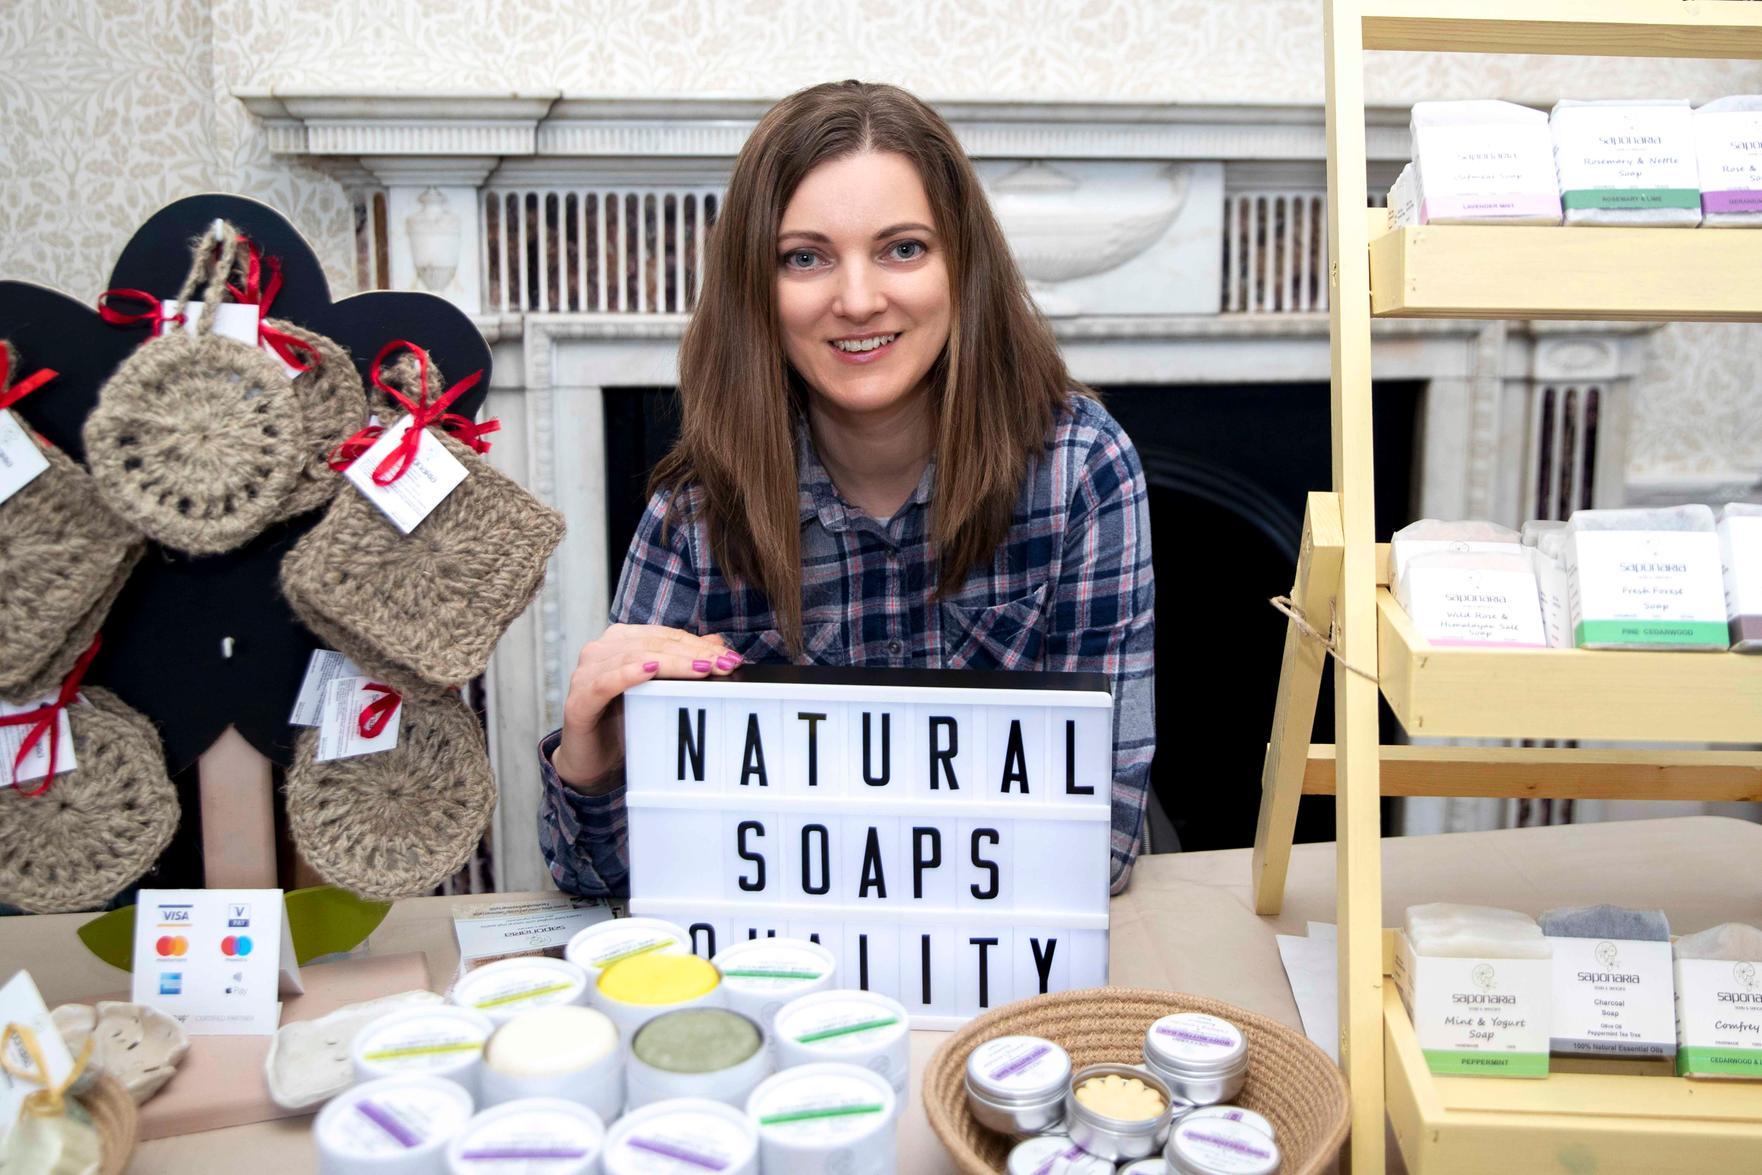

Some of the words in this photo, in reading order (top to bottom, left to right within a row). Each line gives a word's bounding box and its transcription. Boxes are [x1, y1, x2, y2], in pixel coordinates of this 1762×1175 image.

[1584, 157, 1633, 167] Rosemary
[1637, 157, 1645, 165] &
[1648, 156, 1679, 165] Nettle
[1618, 170, 1643, 178] Soap
[1722, 165, 1744, 173] Rose
[1622, 586, 1650, 595] Fresh
[1652, 586, 1683, 595] Forest
[1643, 602, 1670, 611] Soap
[1621, 628, 1640, 636] PINE
[1642, 628, 1695, 637] CEDARWOOD
[677, 707, 1095, 795] NATURAL
[736, 820, 1000, 900] SOAPS
[163, 910, 190, 921] VISA
[235, 906, 245, 917] V
[688, 922, 1058, 1009] LITY
[1577, 971, 1640, 984] saponaria
[1452, 993, 1516, 1005] saponaria
[1594, 998, 1625, 1007] Charcoal
[1601, 1009, 1620, 1018] Soap
[1444, 1016, 1473, 1027] Mint
[1477, 1016, 1486, 1026] &
[1491, 1018, 1526, 1029] Yogurt
[1715, 1020, 1760, 1033] Comfrey
[1469, 1030, 1495, 1041] Soap
[1587, 1030, 1617, 1038] Peppermint
[1573, 1042, 1592, 1050] 100%
[1593, 1043, 1617, 1051] Natural
[1619, 1044, 1649, 1053] Essential
[1650, 1046, 1664, 1054] Oils
[1461, 1058, 1509, 1066] PEPPERMINT
[1710, 1057, 1753, 1065] CEDARWOOD
